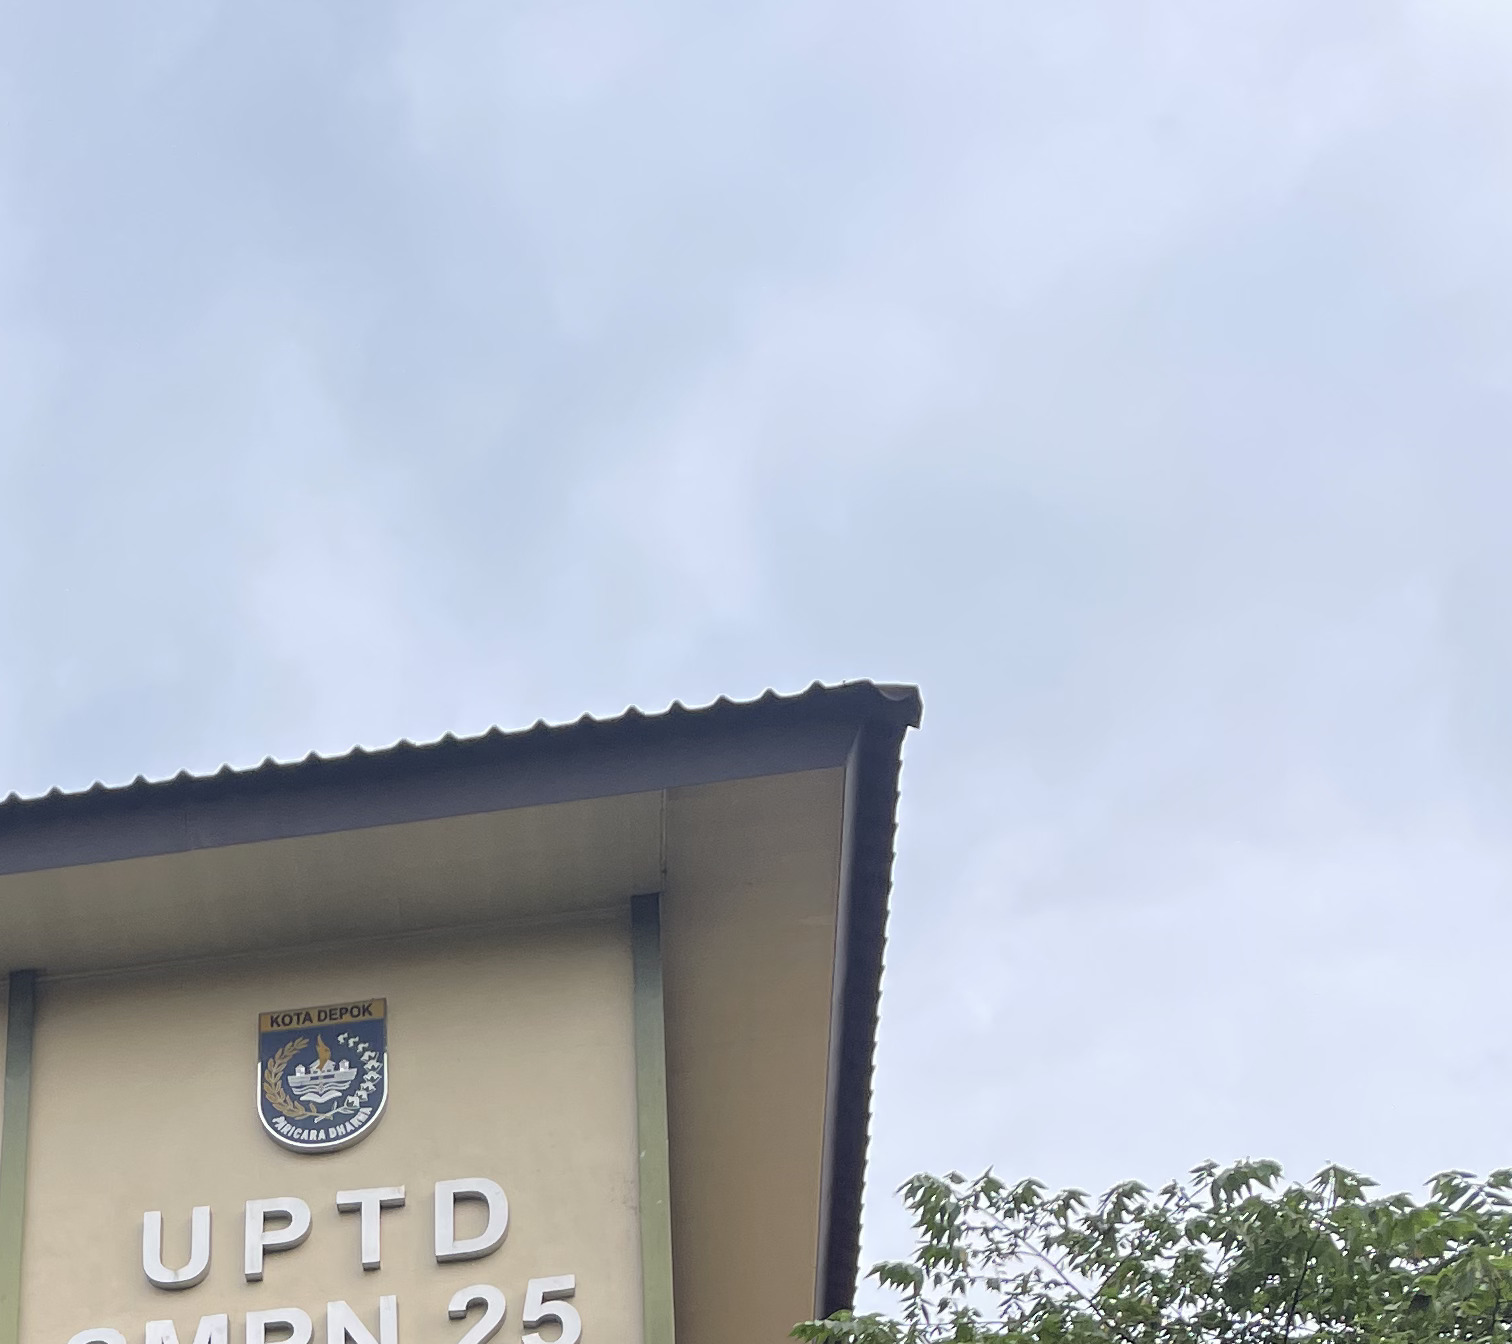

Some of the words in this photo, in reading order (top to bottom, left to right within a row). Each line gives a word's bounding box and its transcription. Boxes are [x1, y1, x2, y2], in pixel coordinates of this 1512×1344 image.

[270, 1011, 313, 1028] KOTA
[317, 1002, 373, 1022] DEPOK
[141, 1178, 509, 1290] UPTD
